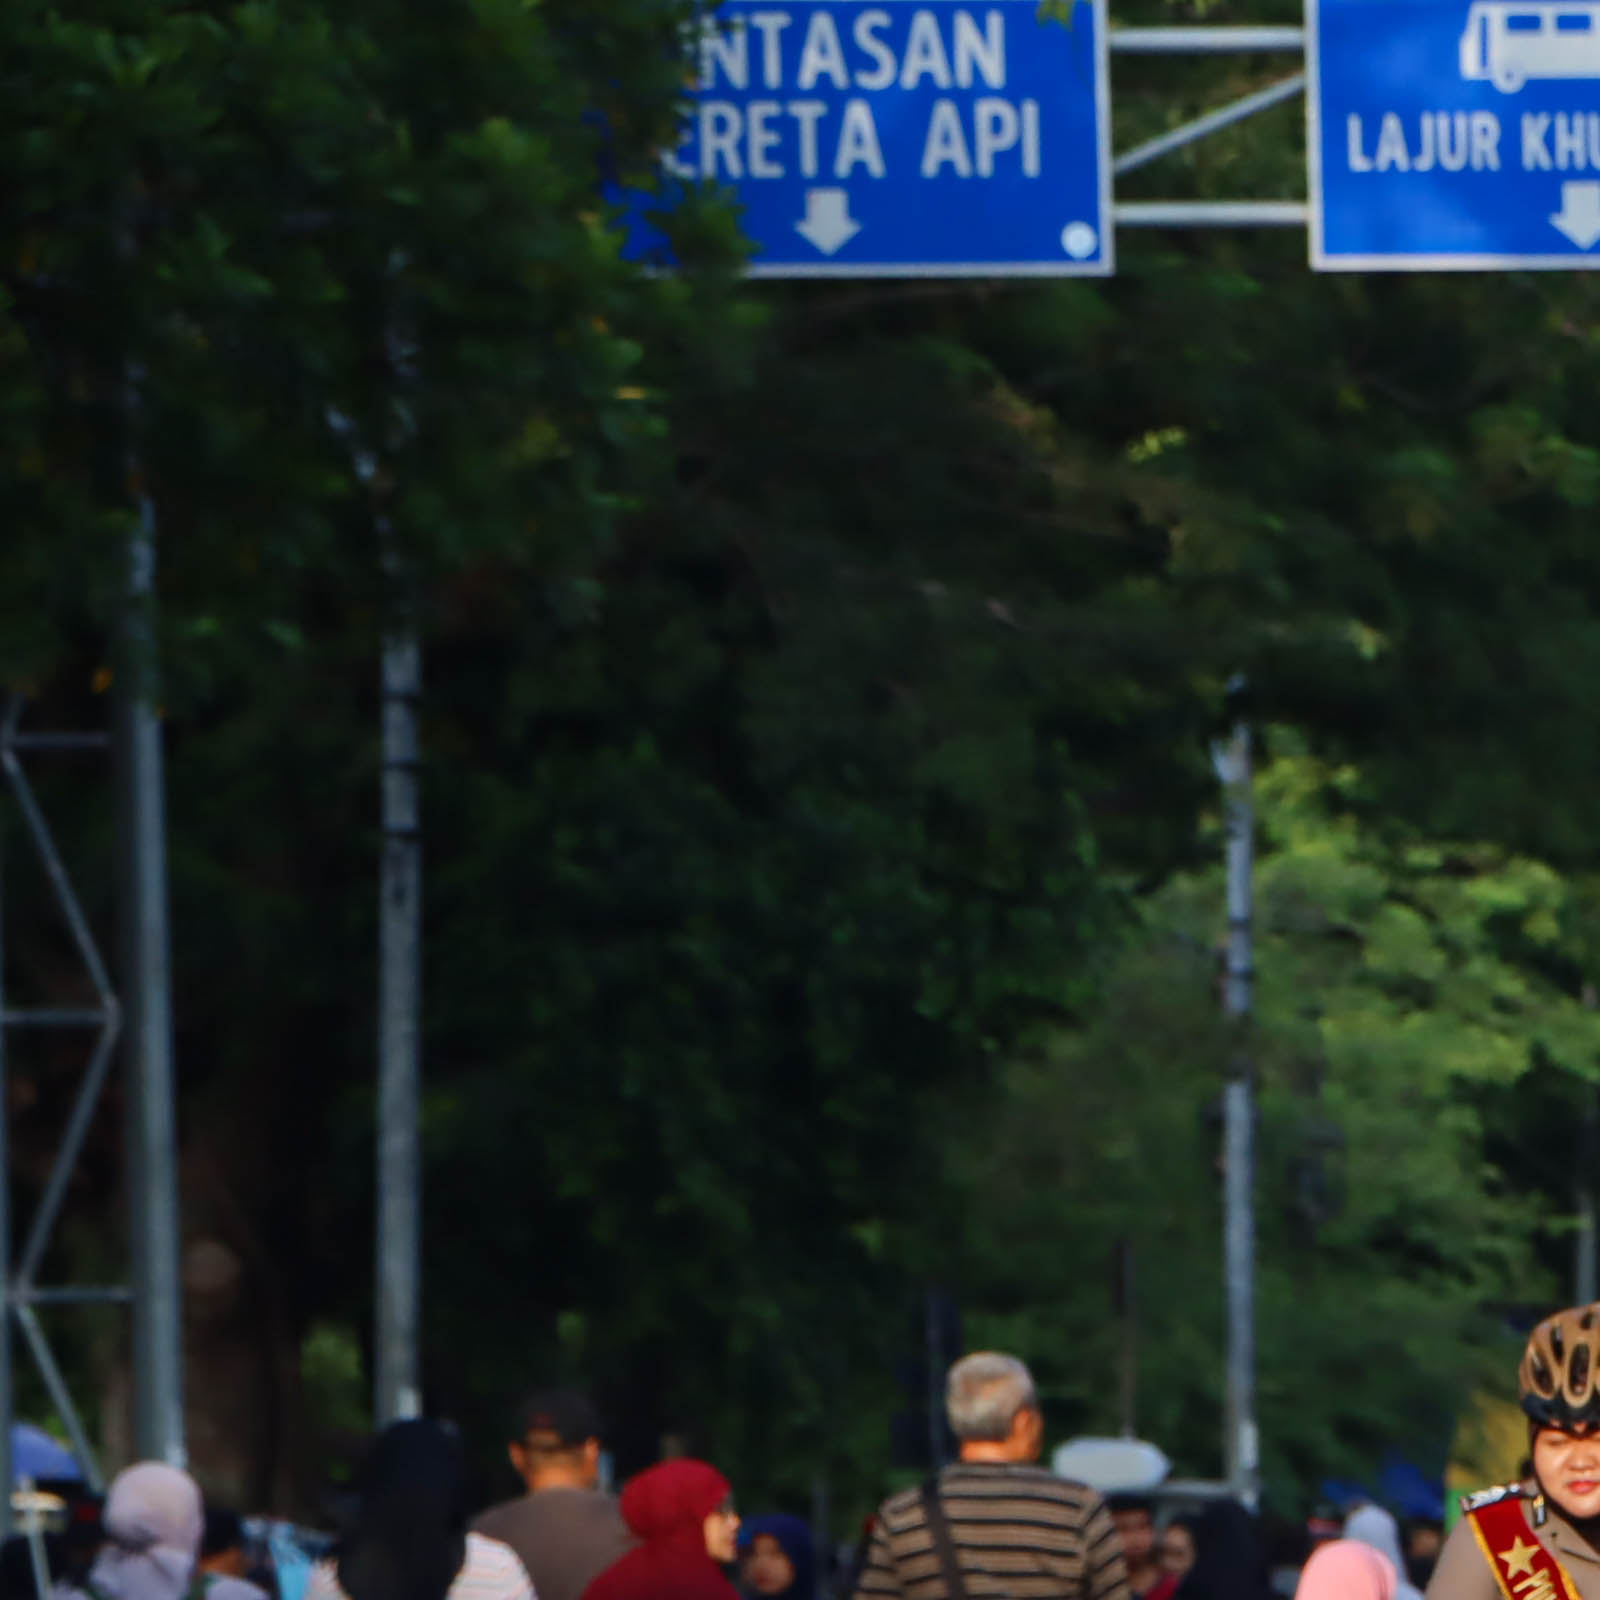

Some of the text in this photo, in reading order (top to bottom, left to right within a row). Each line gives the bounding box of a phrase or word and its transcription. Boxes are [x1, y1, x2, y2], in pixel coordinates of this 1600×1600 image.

[682, 10, 1006, 91] NTASAN
[920, 98, 1041, 179] API
[1346, 111, 1501, 172] LAJUR
